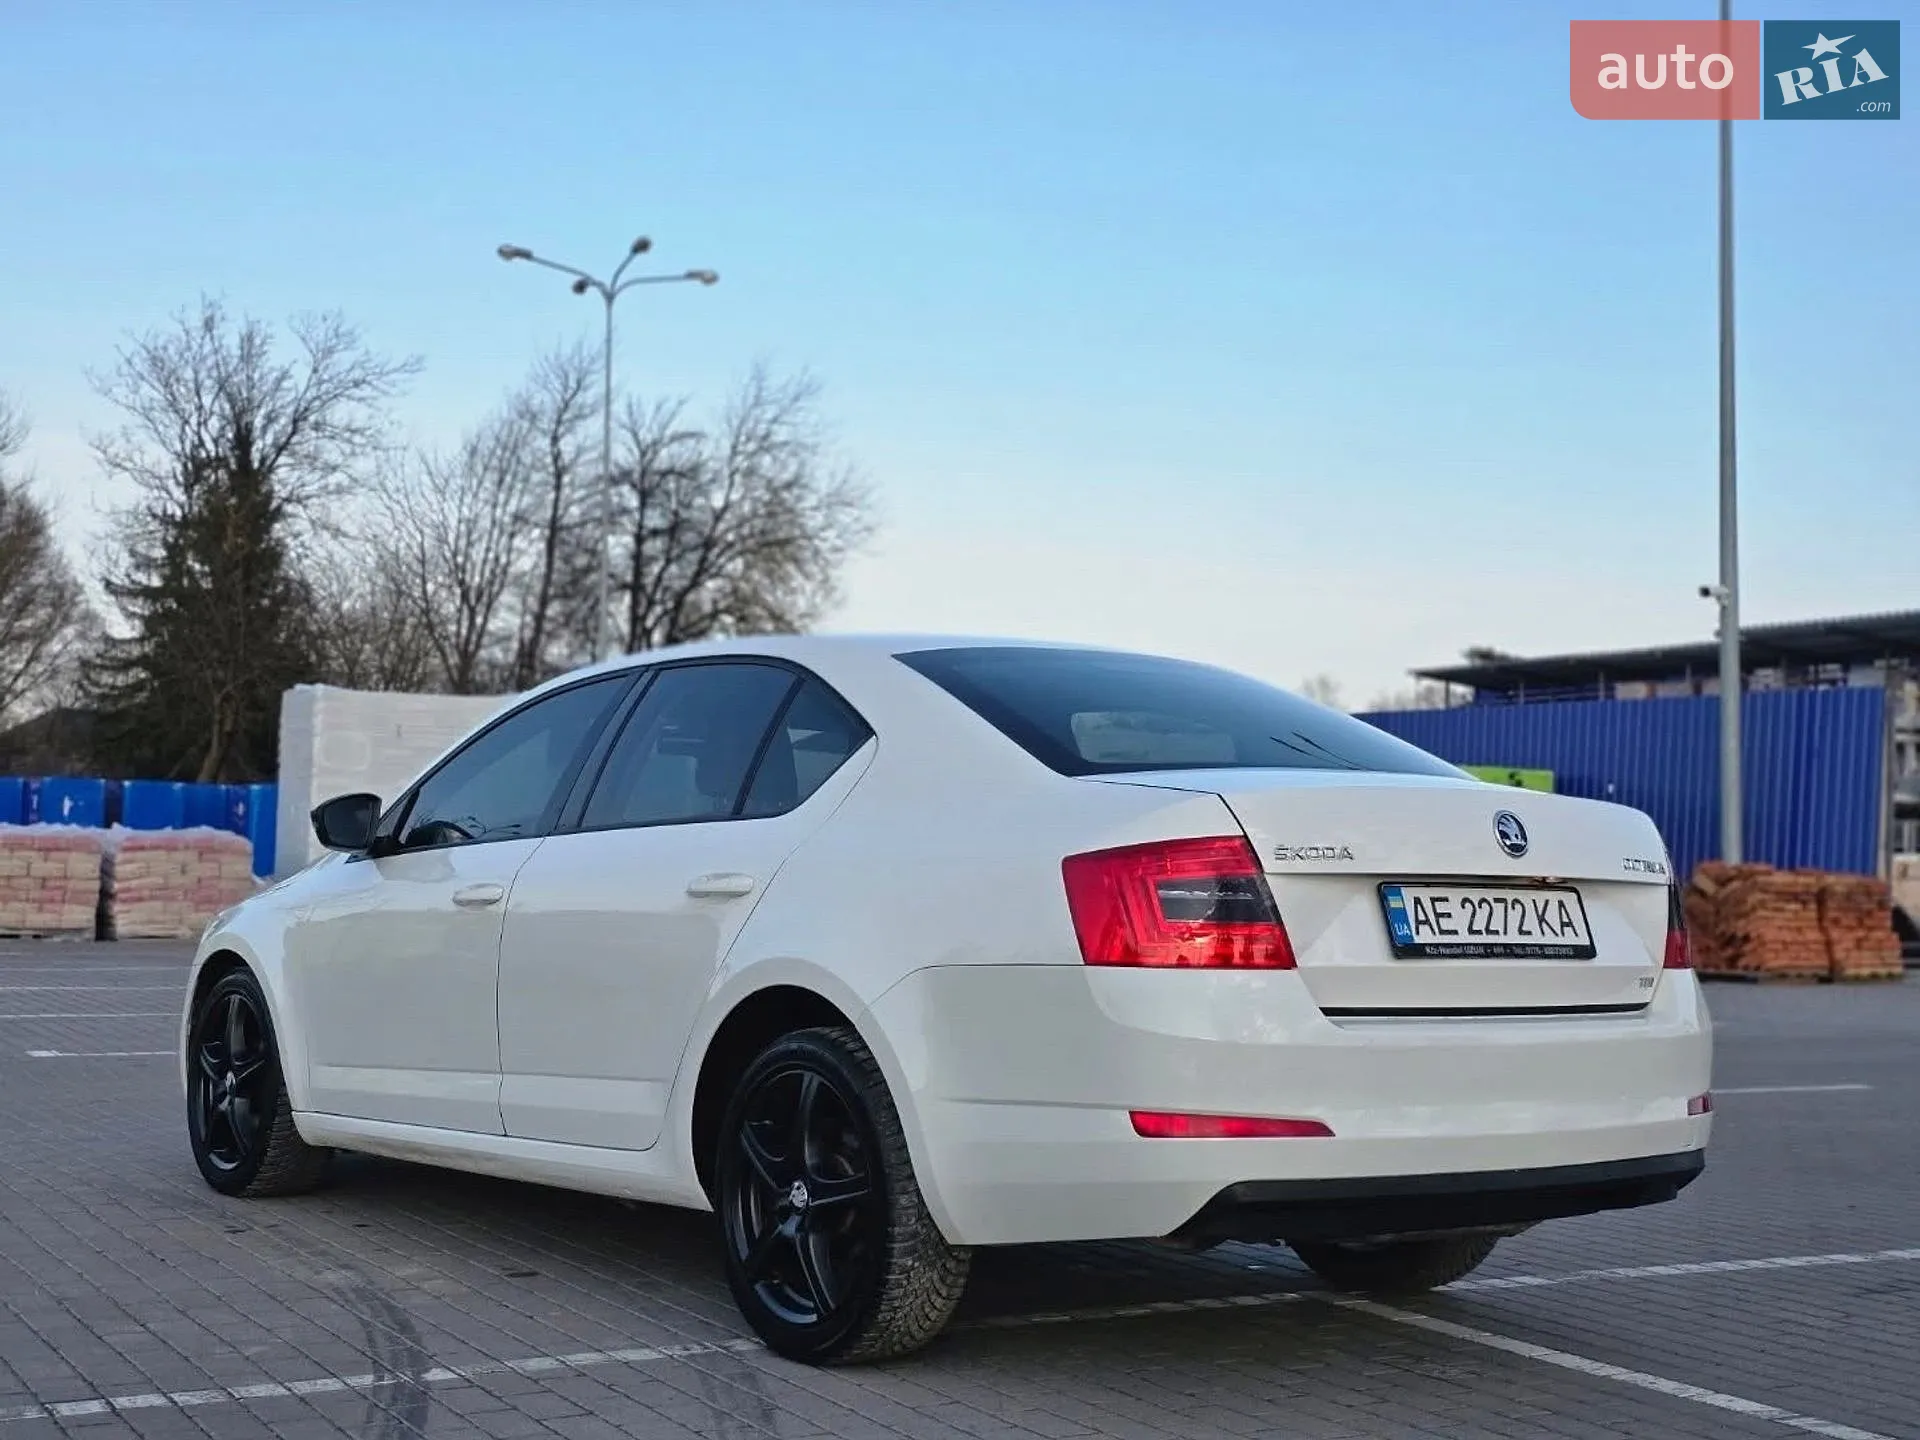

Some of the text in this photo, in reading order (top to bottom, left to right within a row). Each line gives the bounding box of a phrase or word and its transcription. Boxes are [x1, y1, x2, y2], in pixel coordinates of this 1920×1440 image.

[1393, 923, 1411, 936] UA
[1413, 896, 1579, 937] AE 2272 KA
